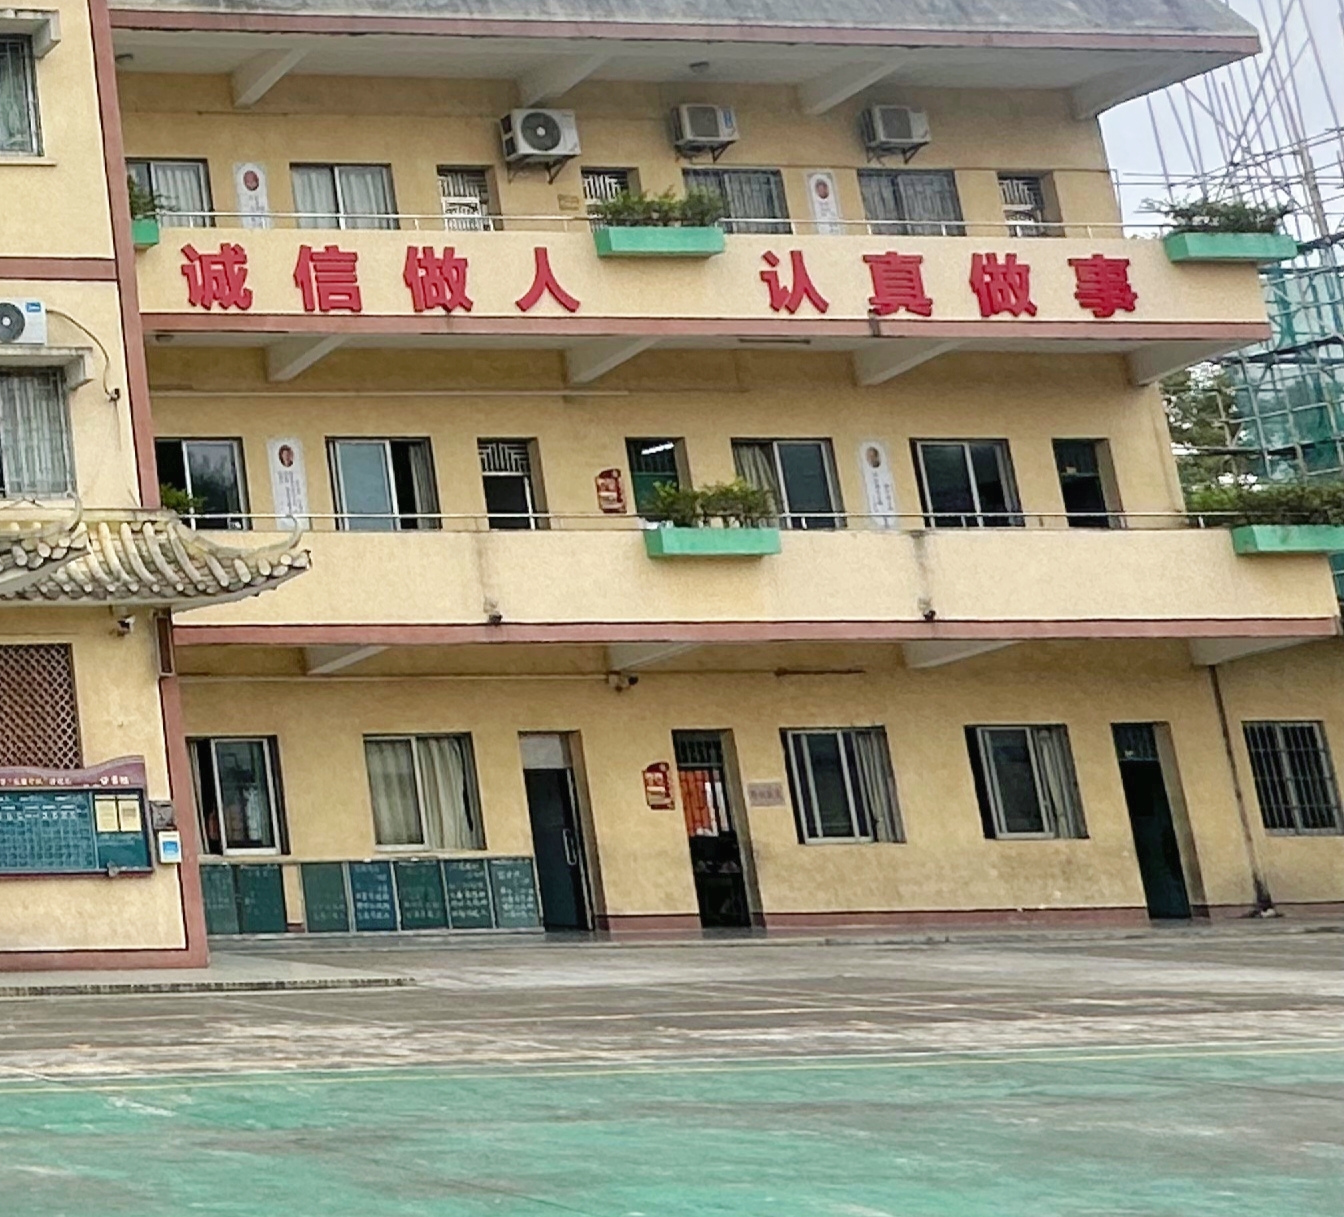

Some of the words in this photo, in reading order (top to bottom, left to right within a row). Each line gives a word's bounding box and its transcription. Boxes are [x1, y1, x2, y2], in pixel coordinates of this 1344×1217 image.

[181, 243, 580, 313] 诚信做人
[760, 250, 1137, 317] 认真做事
